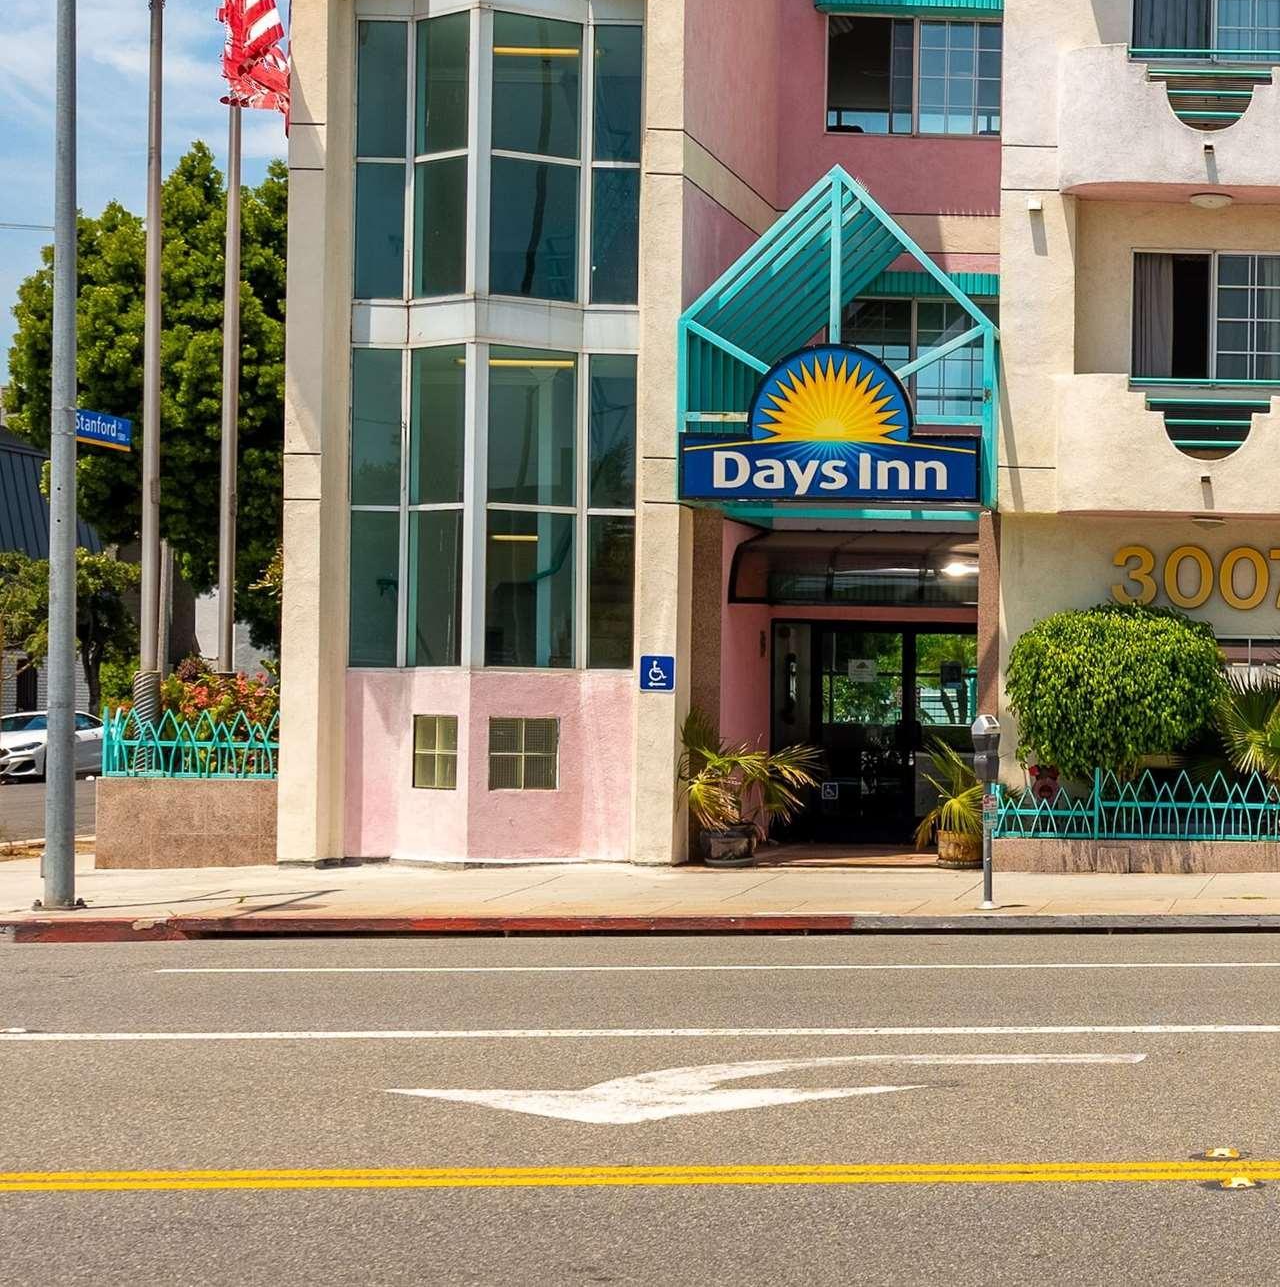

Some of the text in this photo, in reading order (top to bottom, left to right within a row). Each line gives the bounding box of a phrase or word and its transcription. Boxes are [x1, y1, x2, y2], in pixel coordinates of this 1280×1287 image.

[75, 412, 117, 437] Stanford
[713, 451, 948, 496] Days Inn
